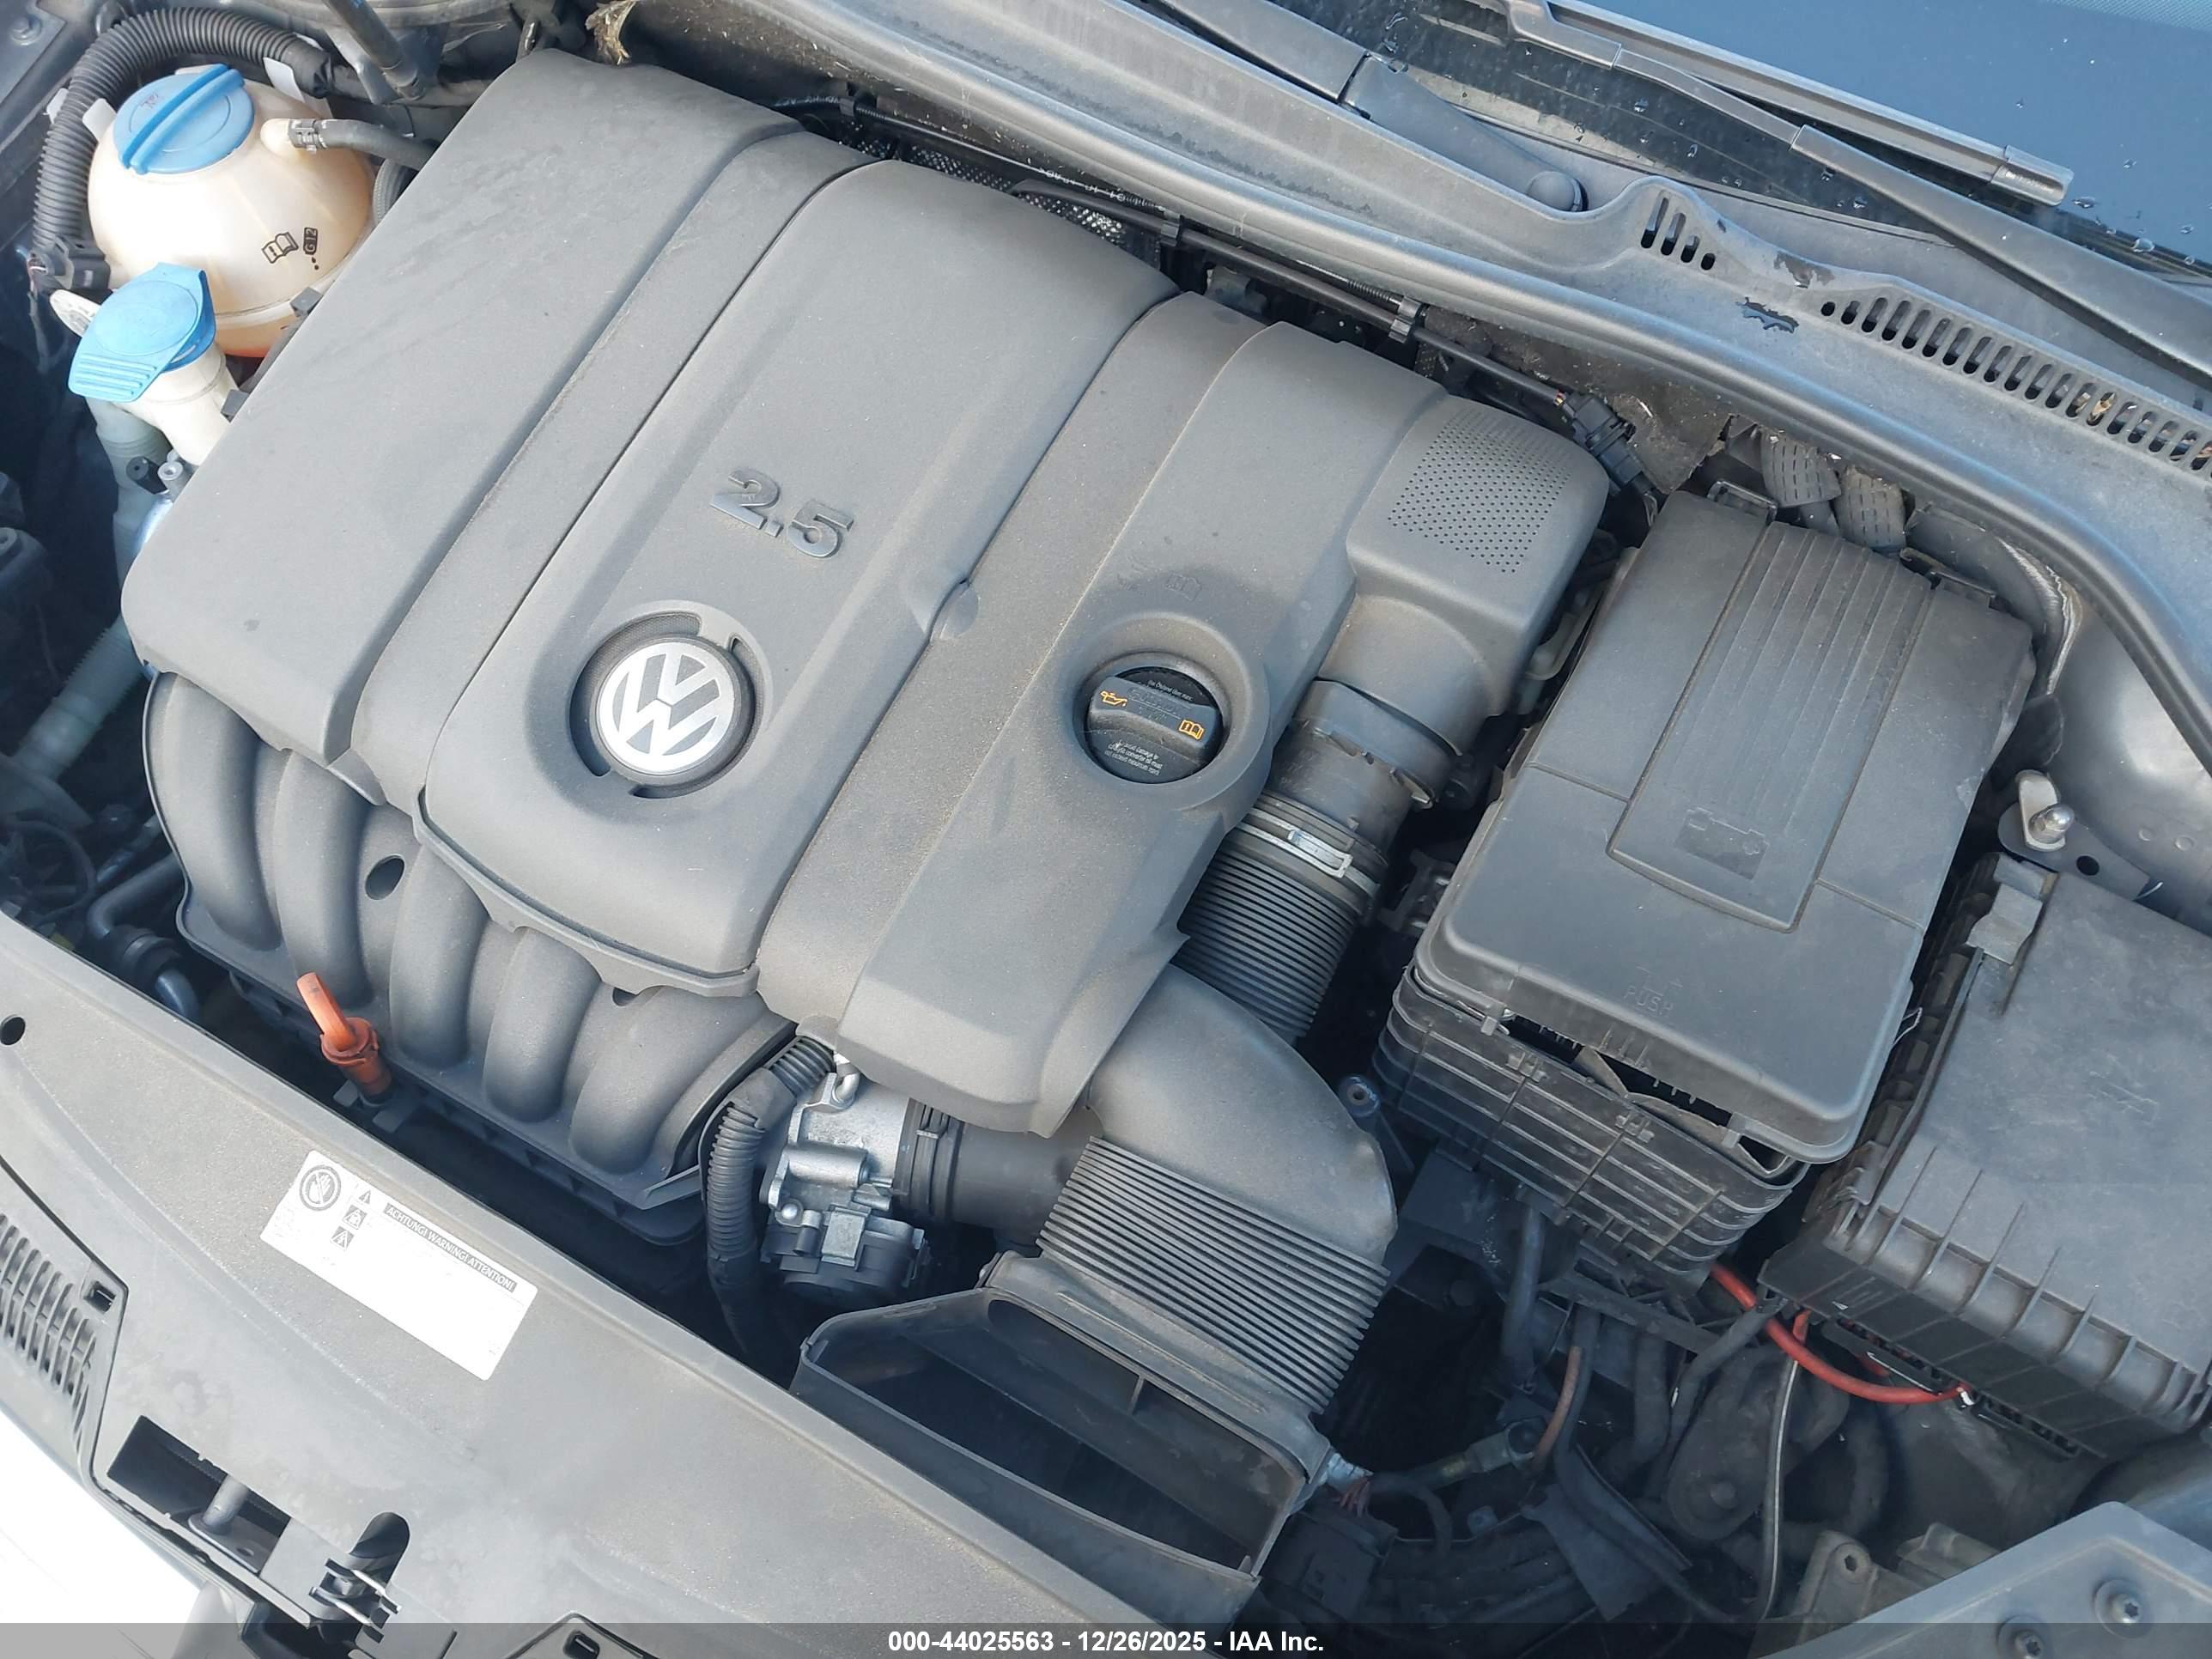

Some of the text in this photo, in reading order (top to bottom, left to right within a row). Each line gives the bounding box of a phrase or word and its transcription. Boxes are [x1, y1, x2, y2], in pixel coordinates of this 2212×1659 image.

[709, 469, 854, 558] 2.5
[599, 642, 734, 772] VW
[386, 1206, 515, 1290] ACHTUNG! WARNING! ATTENTION!
